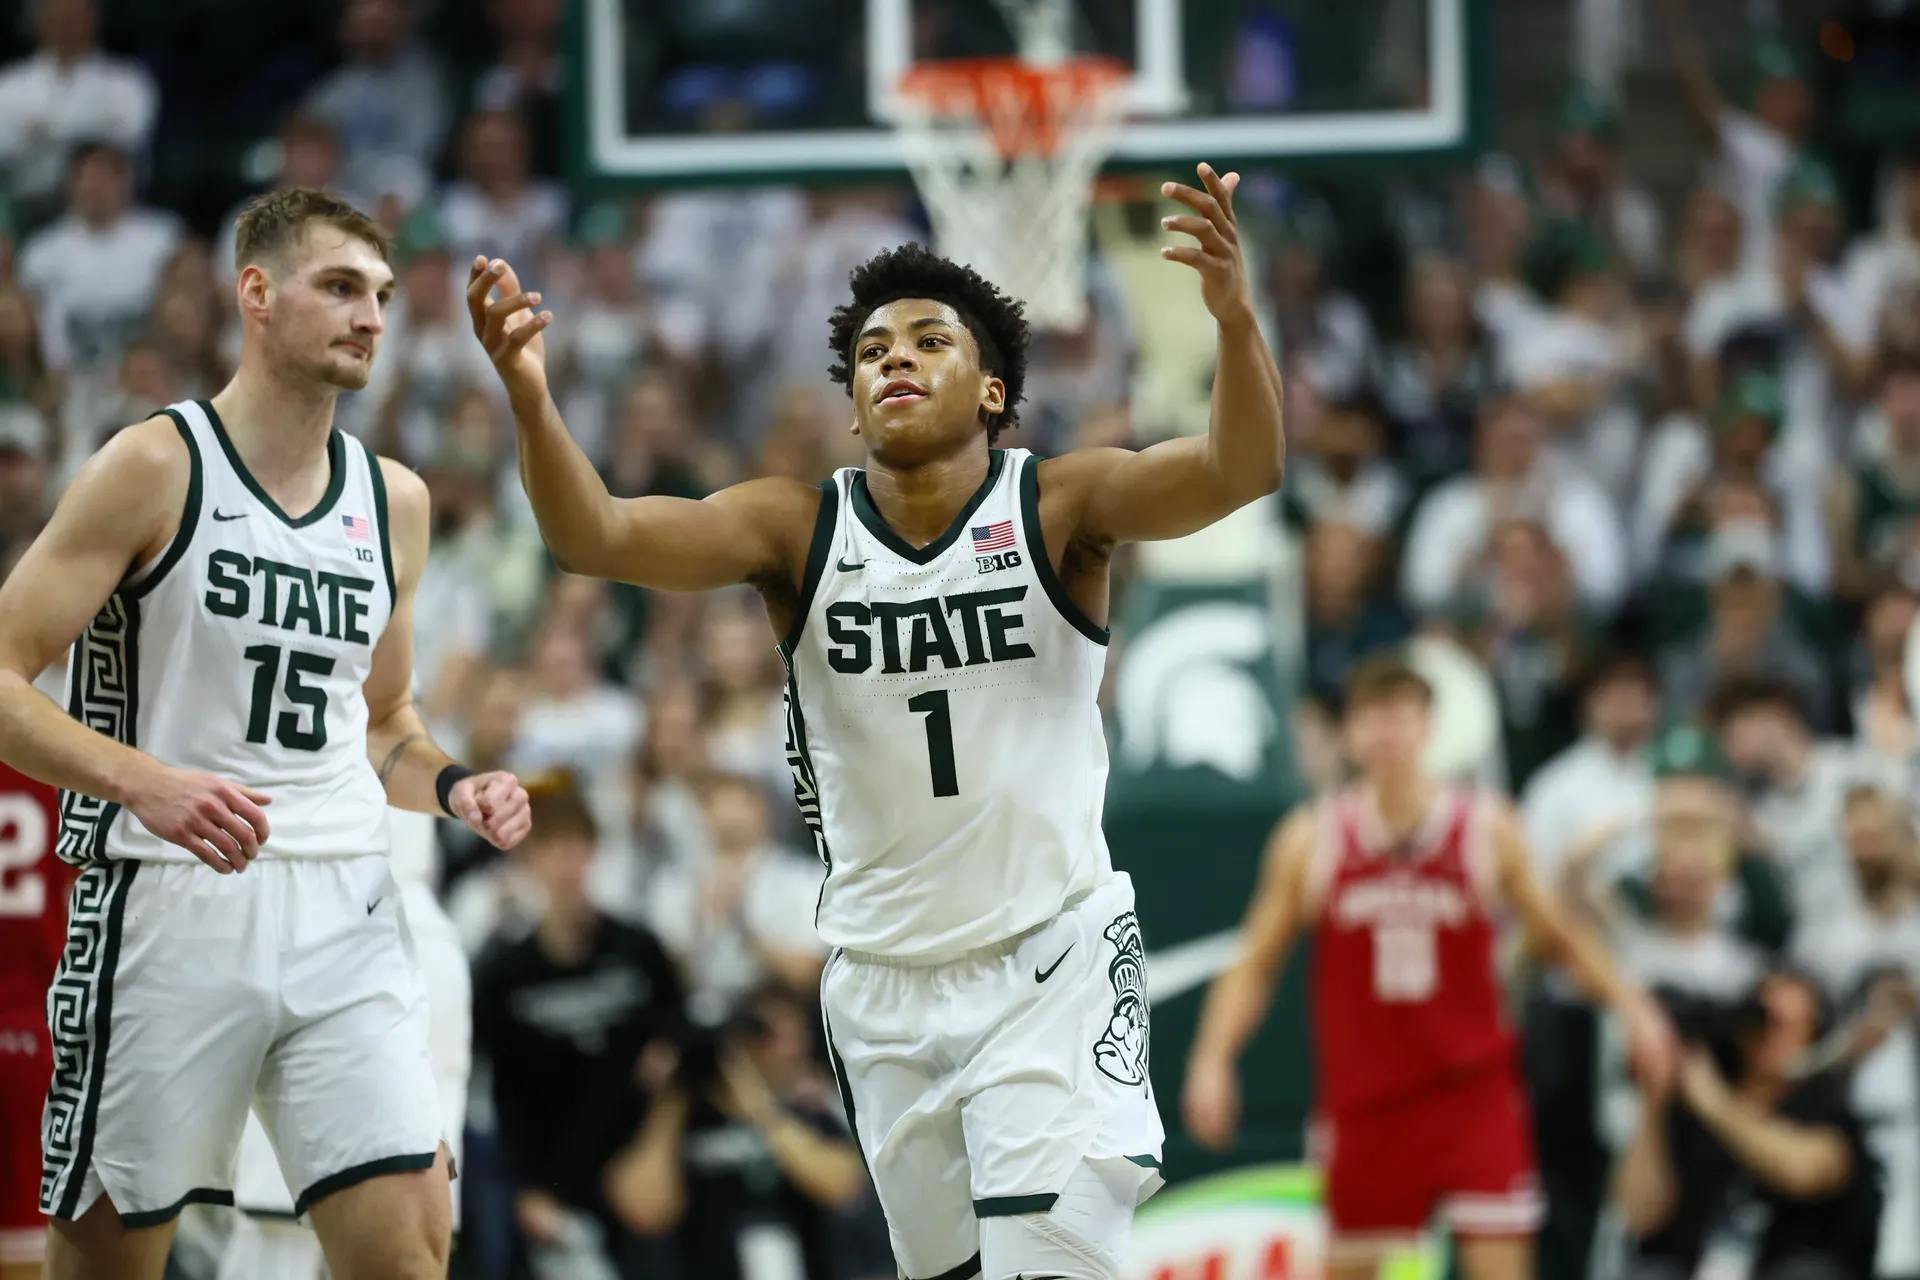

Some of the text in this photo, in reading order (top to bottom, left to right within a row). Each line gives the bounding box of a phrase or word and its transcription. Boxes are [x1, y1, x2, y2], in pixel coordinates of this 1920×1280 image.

[205, 549, 374, 645] STATE
[826, 585, 1035, 674] STATE
[244, 645, 336, 751] 15
[909, 690, 959, 797] 1
